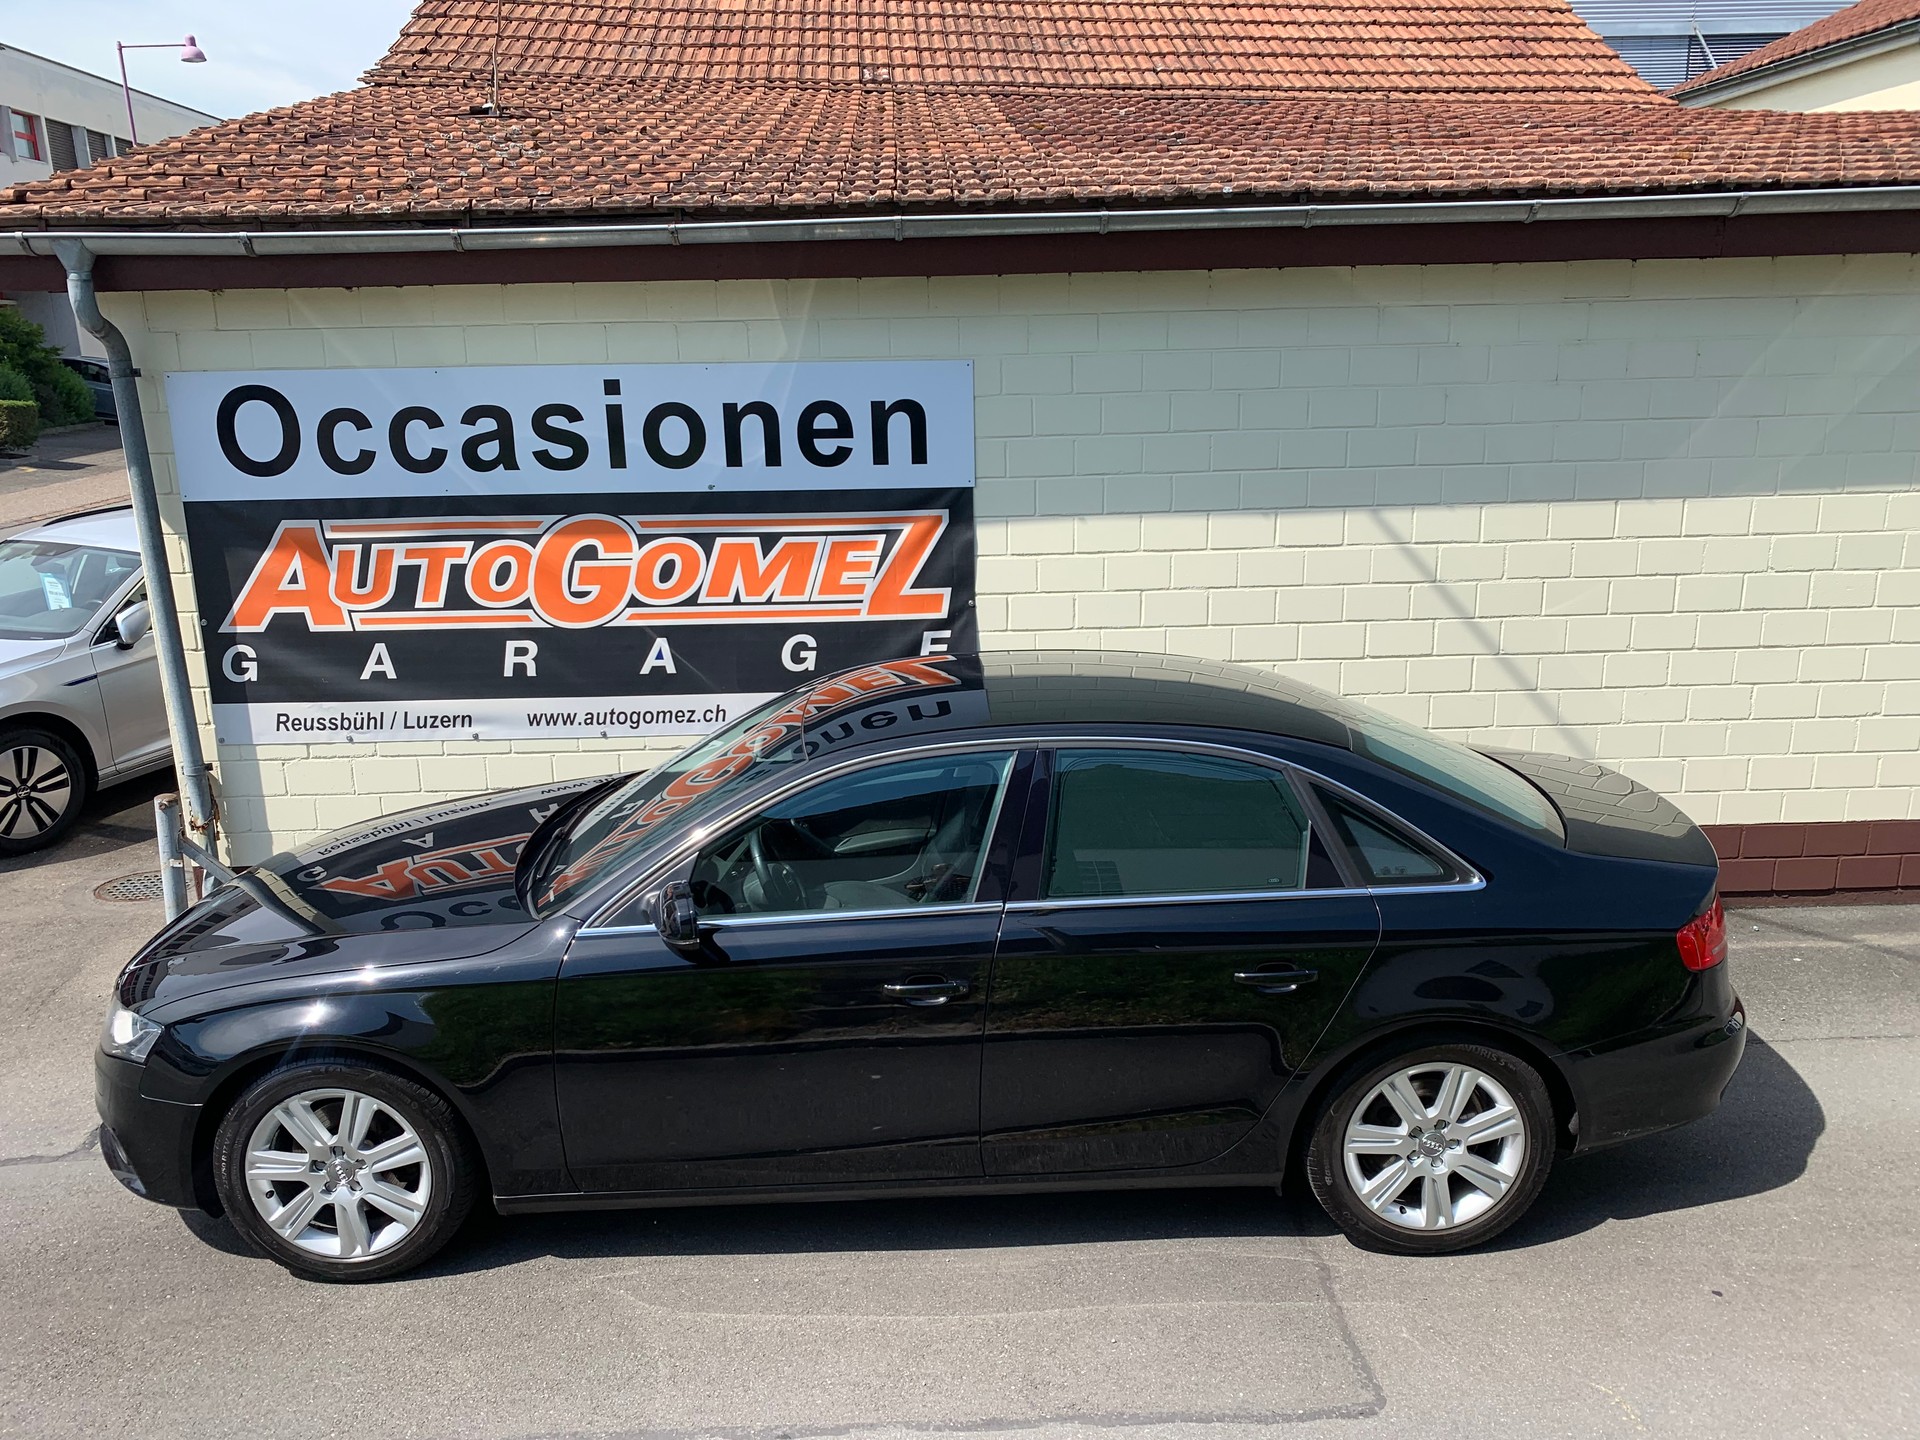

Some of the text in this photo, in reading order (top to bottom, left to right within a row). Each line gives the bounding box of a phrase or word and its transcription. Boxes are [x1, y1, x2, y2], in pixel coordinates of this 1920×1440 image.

[217, 378, 928, 478] Occasionen
[276, 711, 473, 732] Reussbühl / Luzern
[526, 704, 727, 730] www.autogomez.ch
